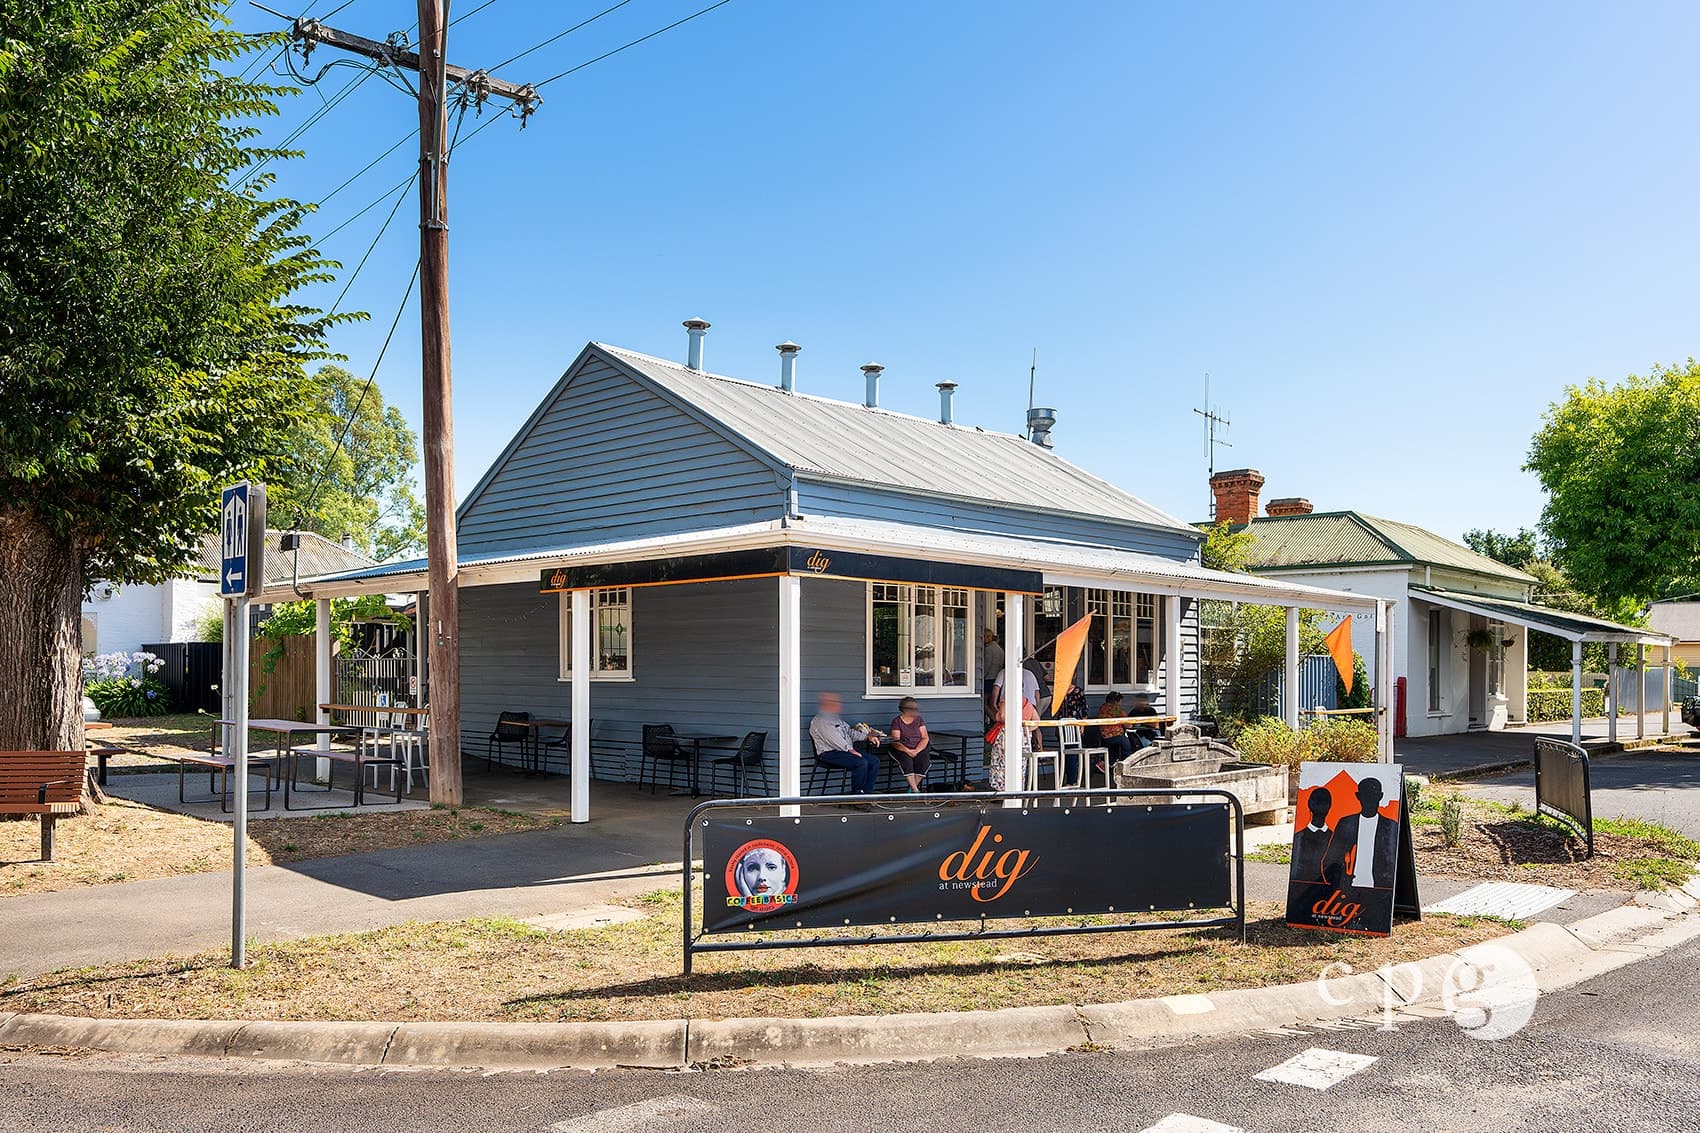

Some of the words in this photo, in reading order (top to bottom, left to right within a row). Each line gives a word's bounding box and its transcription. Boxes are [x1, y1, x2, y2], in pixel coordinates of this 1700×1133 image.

[806, 550, 831, 574] dig
[551, 569, 568, 588] dig
[938, 825, 1040, 902] dig
[938, 882, 949, 890] at
[952, 879, 997, 889] newstead
[726, 896, 761, 907] COFFEE
[762, 894, 798, 904] BASICS
[1312, 889, 1366, 927] dig
